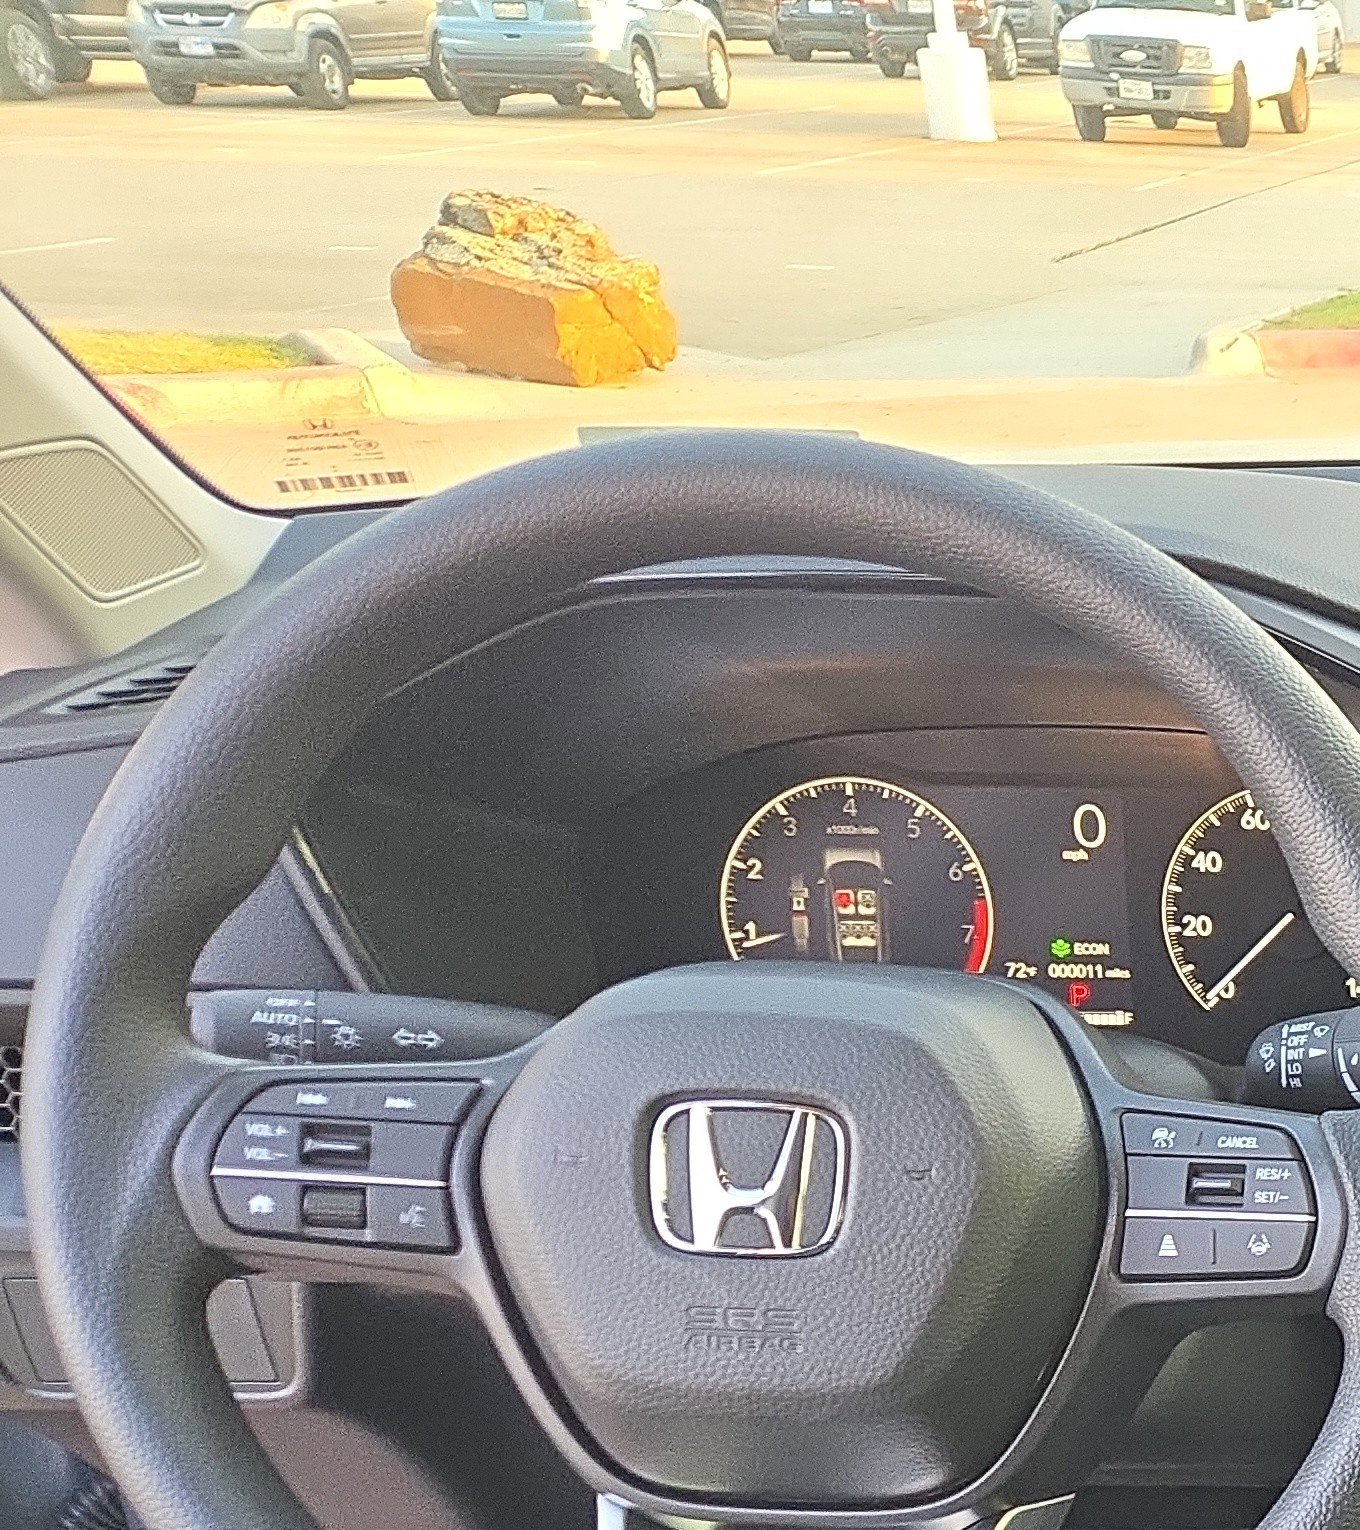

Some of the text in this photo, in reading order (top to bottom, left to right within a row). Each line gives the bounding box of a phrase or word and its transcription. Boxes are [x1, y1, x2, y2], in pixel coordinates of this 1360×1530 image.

[843, 798, 858, 817] 4
[783, 817, 798, 837] 3
[906, 819, 921, 838] 5
[1073, 803, 1107, 849] 0
[1240, 809, 1271, 831] 60
[746, 857, 764, 880] 2
[949, 862, 963, 881] 6
[1191, 851, 1223, 873] 40
[743, 920, 756, 940] 1
[961, 925, 975, 944] 7
[1181, 914, 1213, 937] 20
[1073, 942, 1110, 956] ECON
[1047, 963, 1103, 978] 000011
[1068, 981, 1091, 1007] P
[250, 1011, 301, 1026] AUTO
[1287, 1034, 1308, 1046] OFF
[1217, 1136, 1259, 1149] CANCEL
[1255, 1167, 1292, 1181] RES/+
